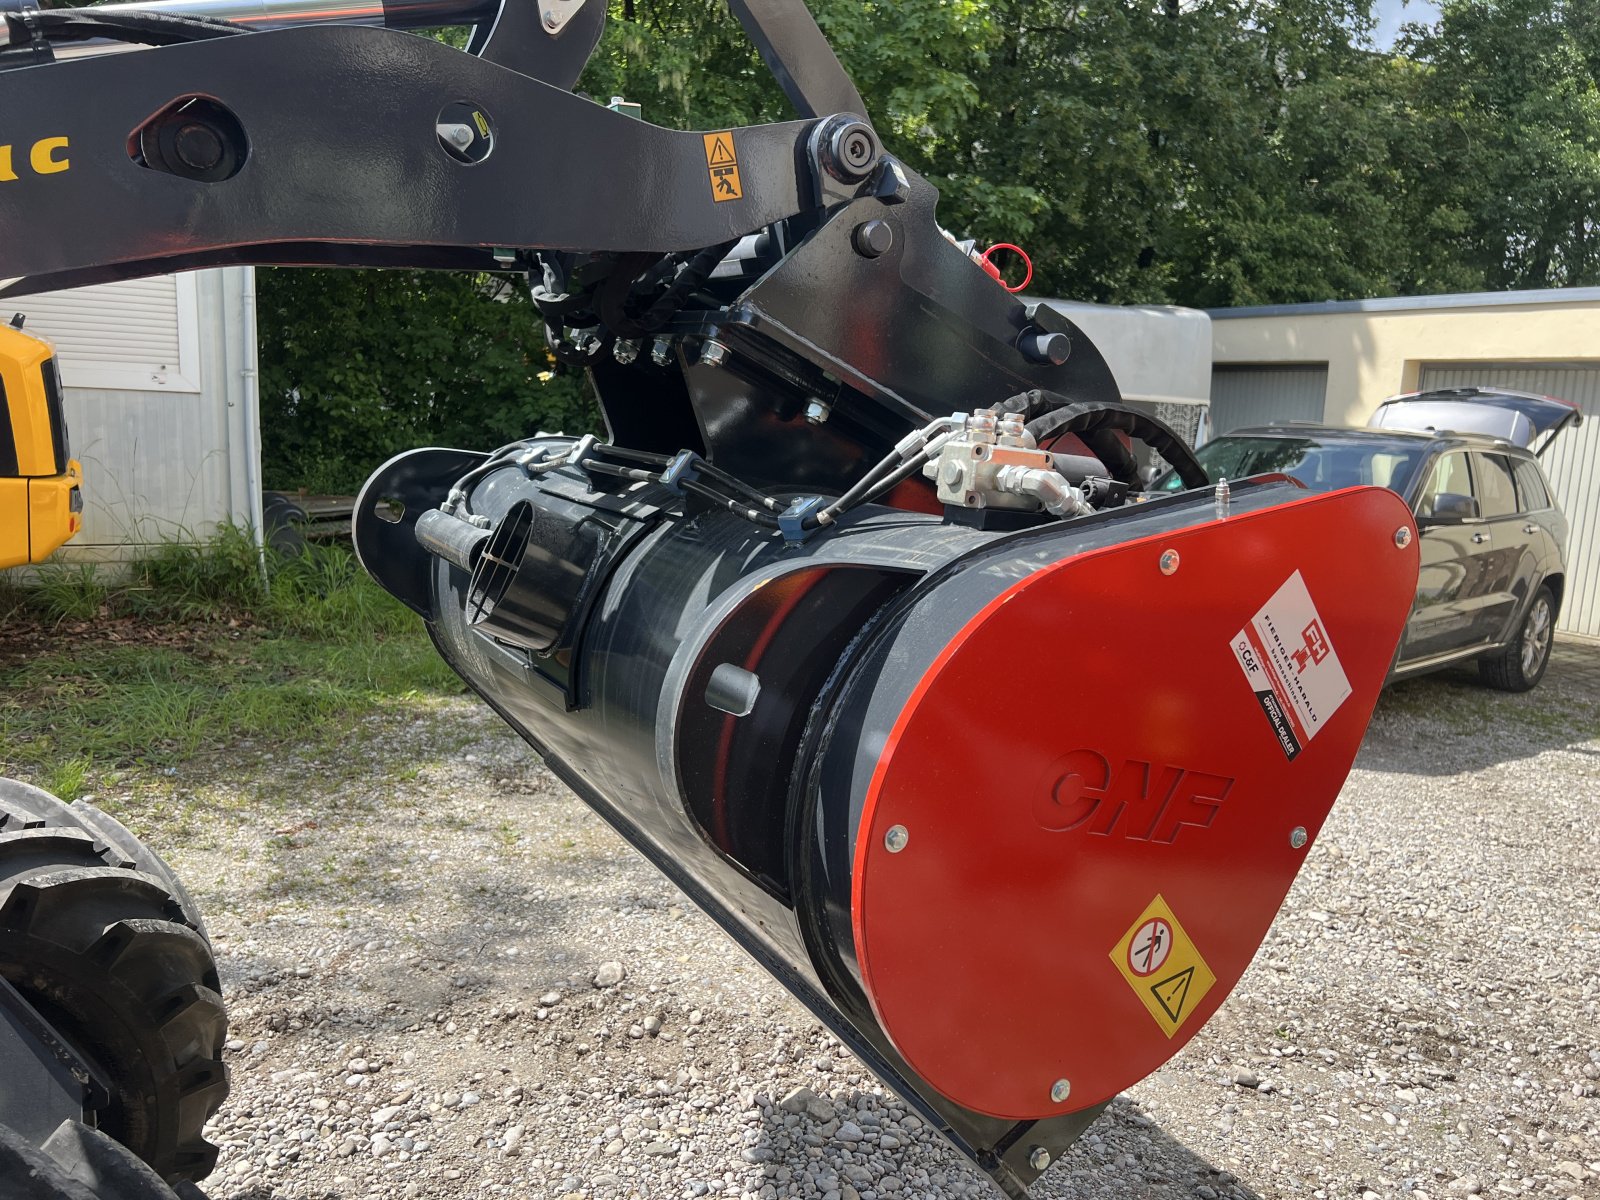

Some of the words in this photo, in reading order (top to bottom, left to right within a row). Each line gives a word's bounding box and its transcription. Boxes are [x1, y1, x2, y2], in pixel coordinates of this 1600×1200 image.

[1241, 647, 1259, 676] C&F
[1305, 623, 1326, 660] FH
[1263, 695, 1282, 728] OFFICIAL
[1277, 725, 1295, 754] DEALER
[1031, 749, 1236, 844] CNF
